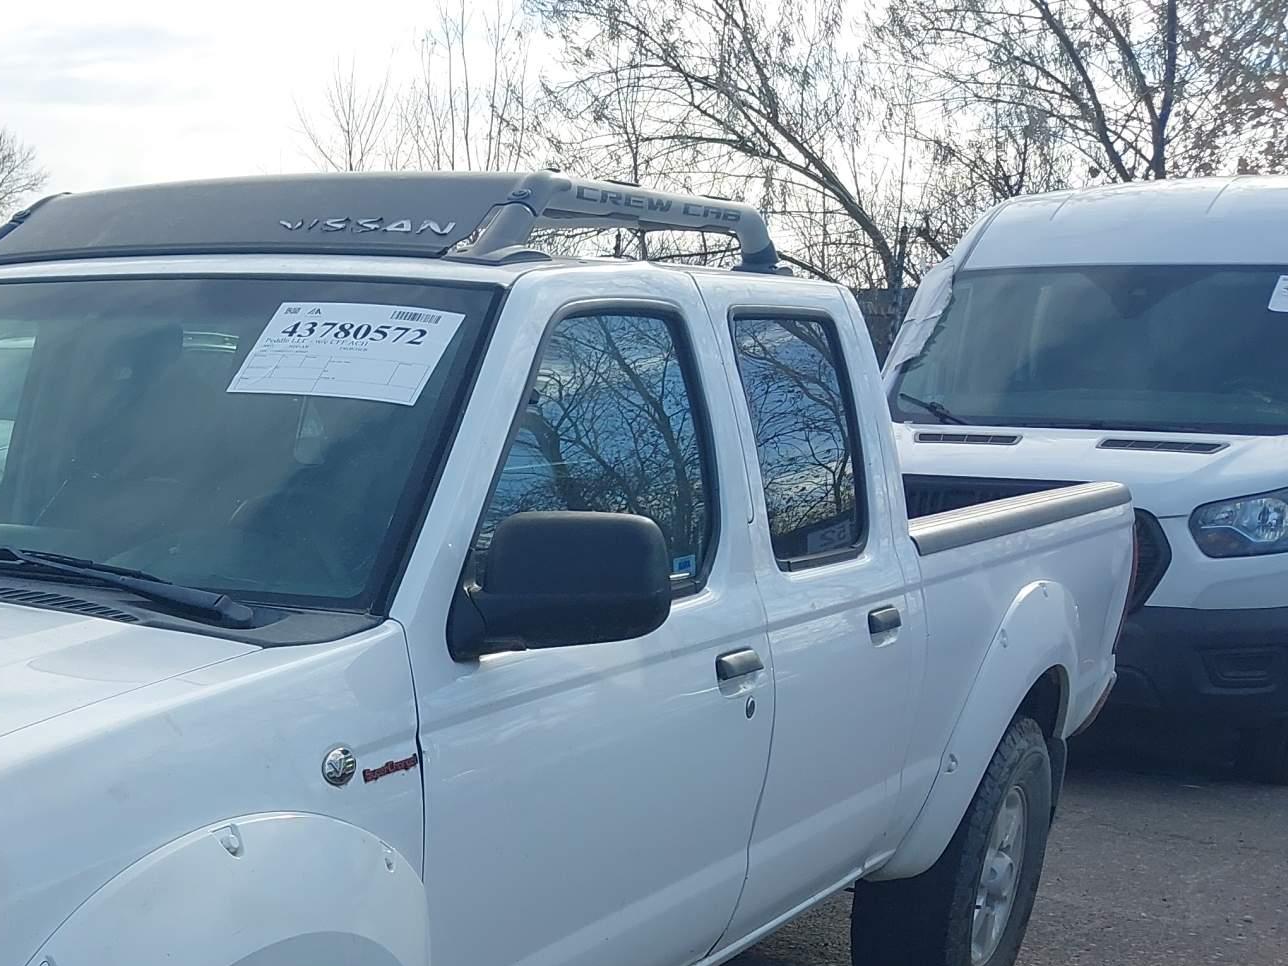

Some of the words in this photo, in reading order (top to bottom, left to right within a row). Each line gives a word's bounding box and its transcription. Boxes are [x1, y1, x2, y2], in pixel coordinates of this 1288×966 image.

[576, 185, 673, 213] CREW
[682, 203, 742, 222] CAB
[281, 320, 428, 346] 43780572
